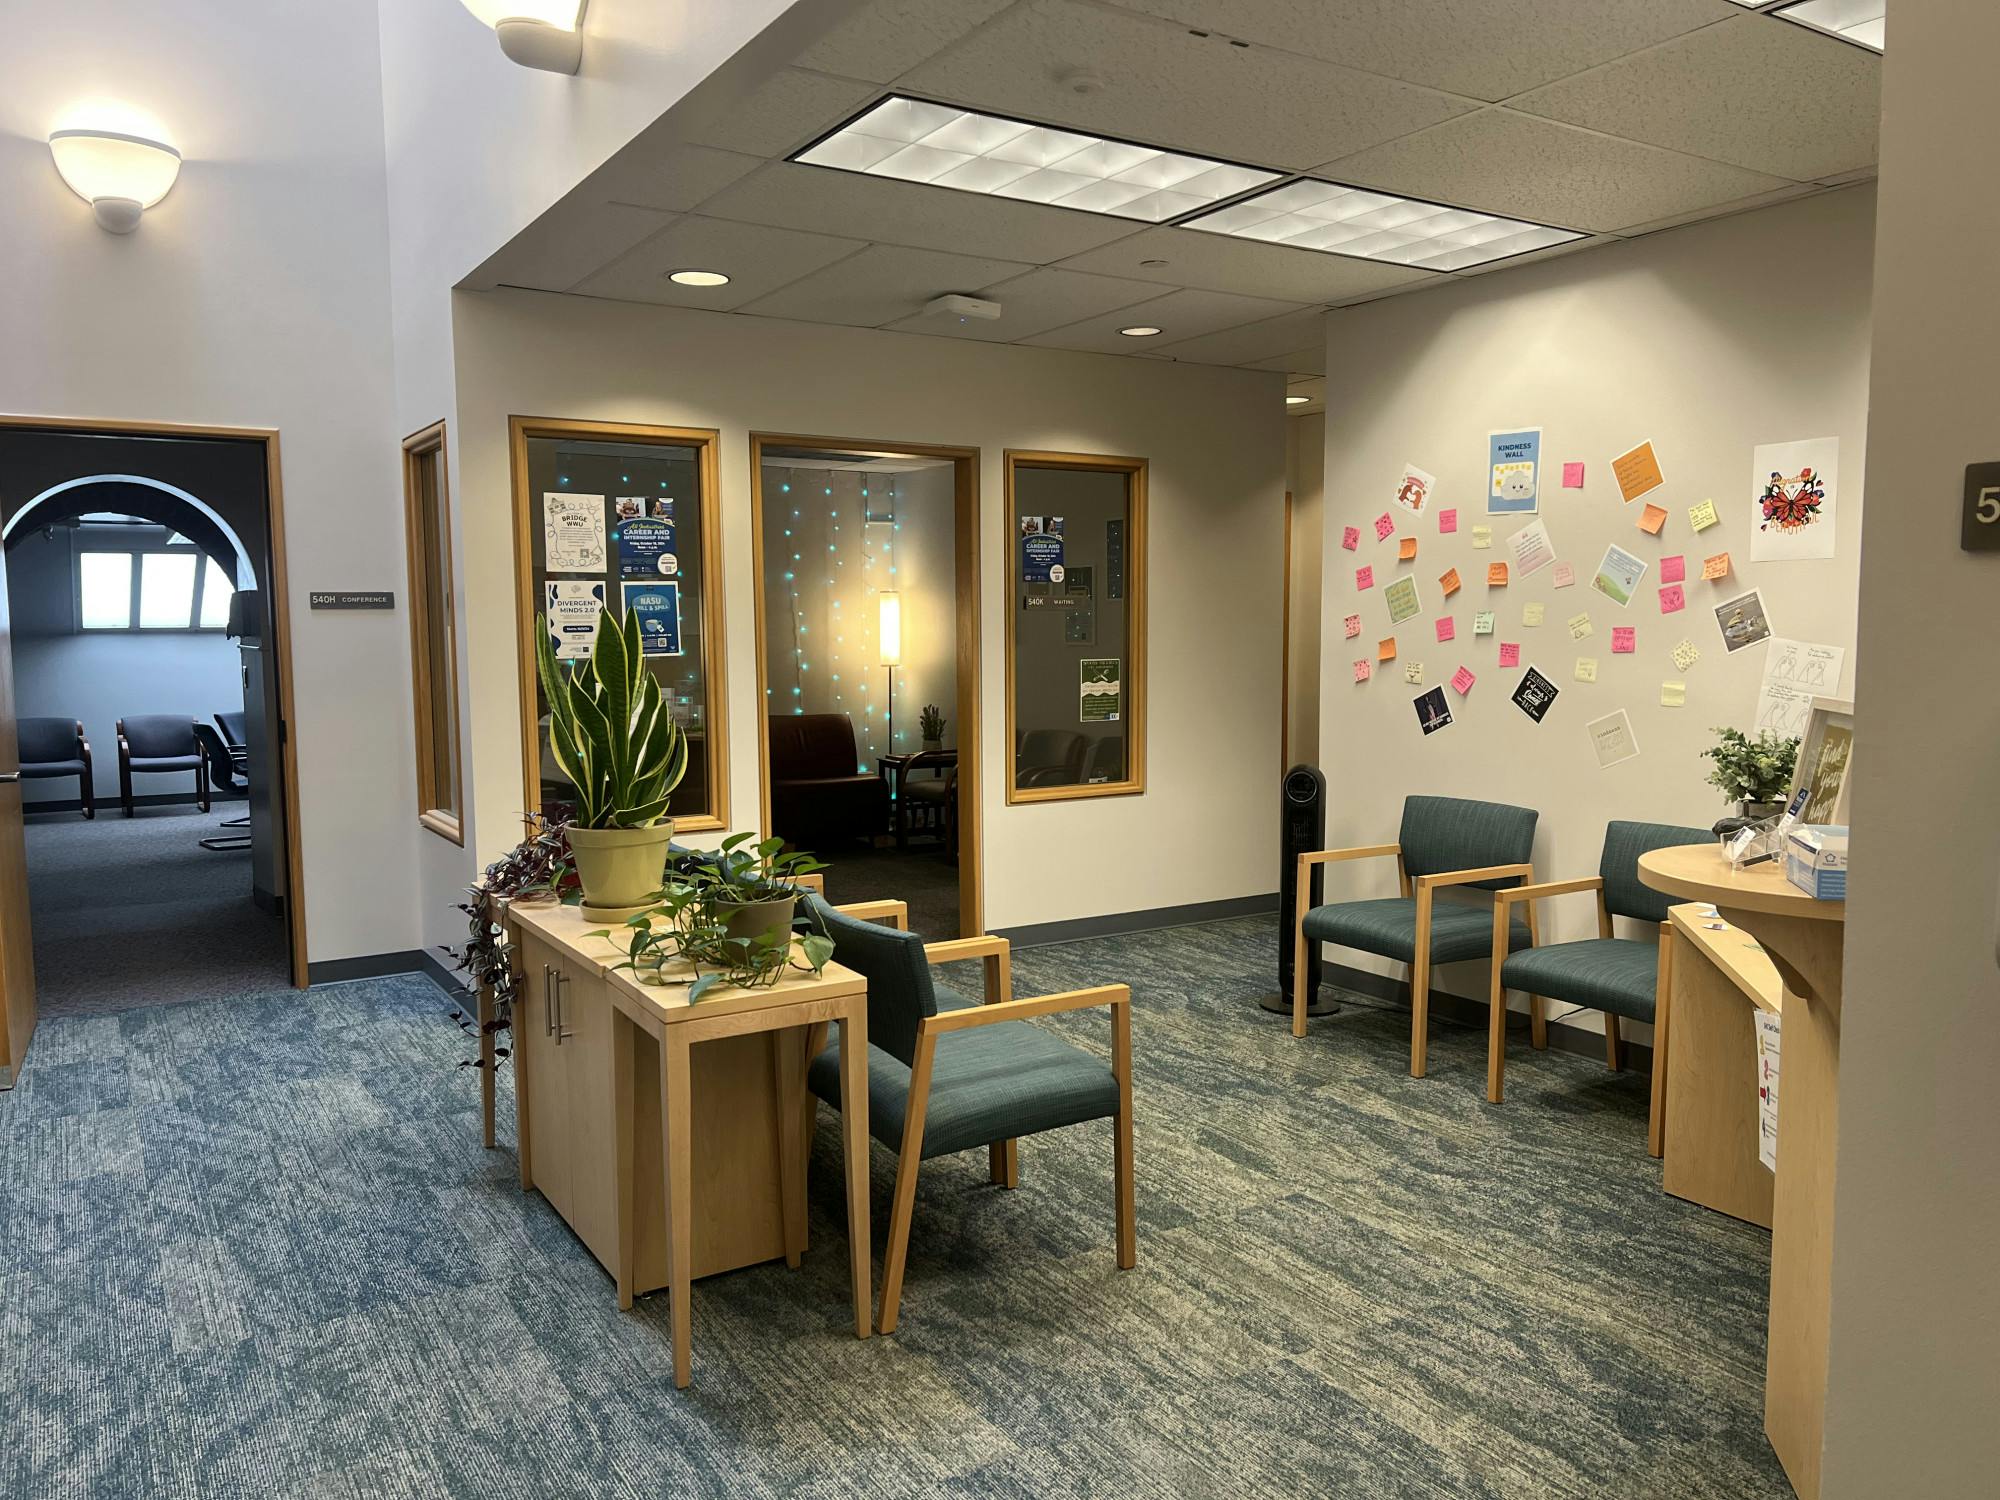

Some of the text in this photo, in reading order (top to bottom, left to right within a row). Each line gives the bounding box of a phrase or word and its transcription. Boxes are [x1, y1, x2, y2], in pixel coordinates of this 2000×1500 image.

[1497, 443, 1532, 451] KINDNESS
[312, 595, 336, 604] 540H
[640, 597, 662, 605] NASU
[1028, 598, 1044, 606] 540K
